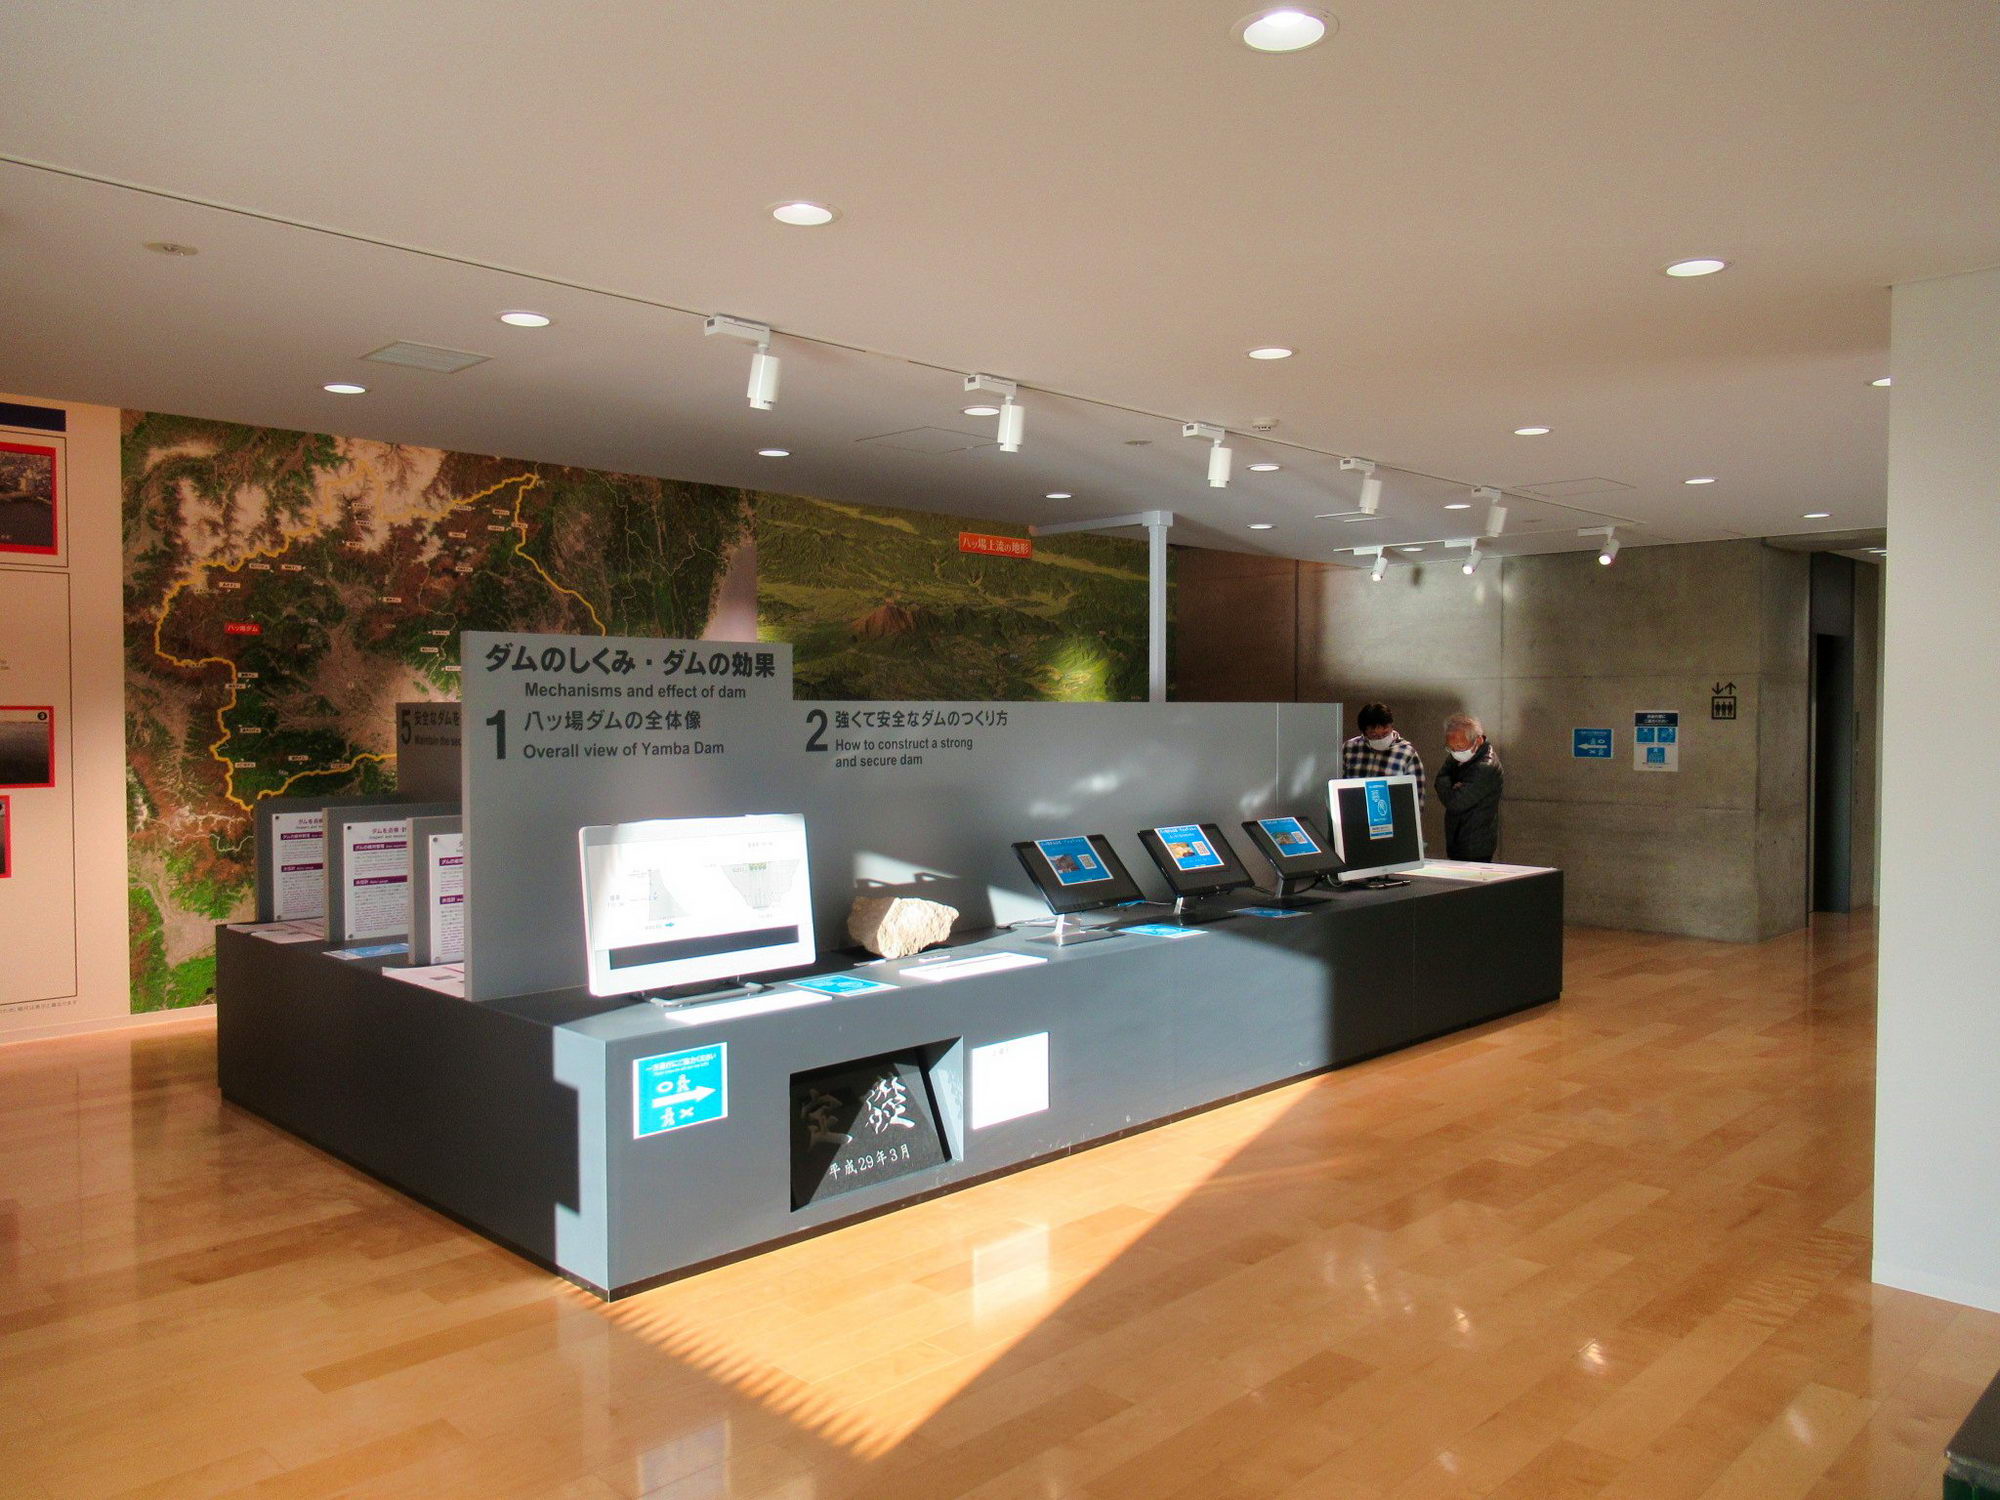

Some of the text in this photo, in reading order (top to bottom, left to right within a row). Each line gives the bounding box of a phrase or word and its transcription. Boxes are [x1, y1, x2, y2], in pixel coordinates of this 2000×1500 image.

[485, 642, 776, 678] ダムのしくみ・ダムの効果
[525, 682, 746, 698] Mechanisms and effect of dam
[524, 710, 701, 732] 八ッ場ダムの全体像
[835, 710, 1008, 729] 強くて安全なダムのつくり方
[486, 710, 507, 760] 1
[805, 709, 829, 752] 2
[523, 741, 724, 760] Overall view of Yamba Dam
[835, 738, 973, 752] How to construct a strong
[835, 754, 923, 768] and secure dam
[829, 1143, 910, 1180] 平成29年3月
